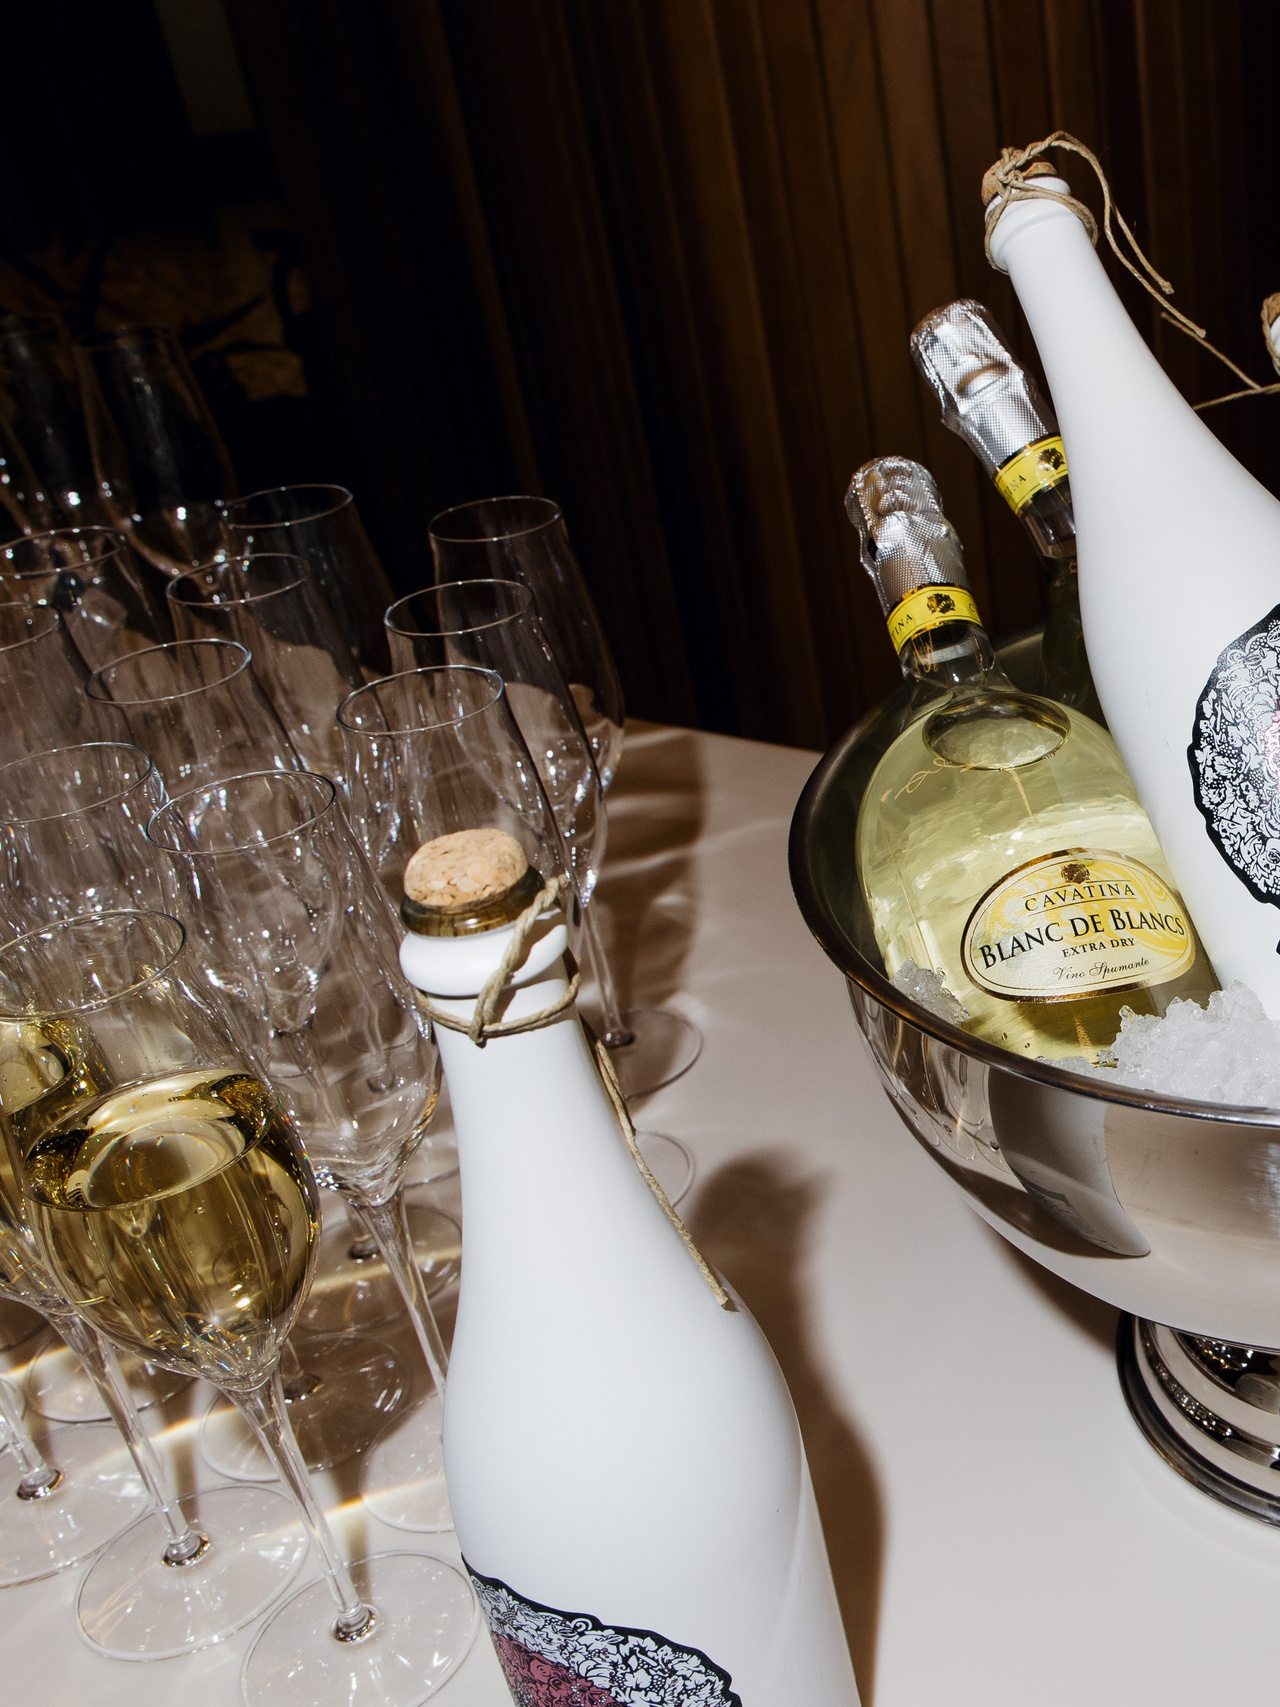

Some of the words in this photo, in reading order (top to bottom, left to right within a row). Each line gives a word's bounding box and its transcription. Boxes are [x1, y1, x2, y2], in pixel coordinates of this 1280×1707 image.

[1025, 882, 1136, 912] CAVATINA
[979, 922, 1064, 969] BLANC
[1069, 914, 1105, 937] DE
[1109, 908, 1185, 936] BLANCS
[1063, 942, 1107, 958] EXTRA
[1110, 937, 1135, 948] DRY
[1053, 965, 1087, 982] Vino
[1090, 957, 1150, 980] Spumante
